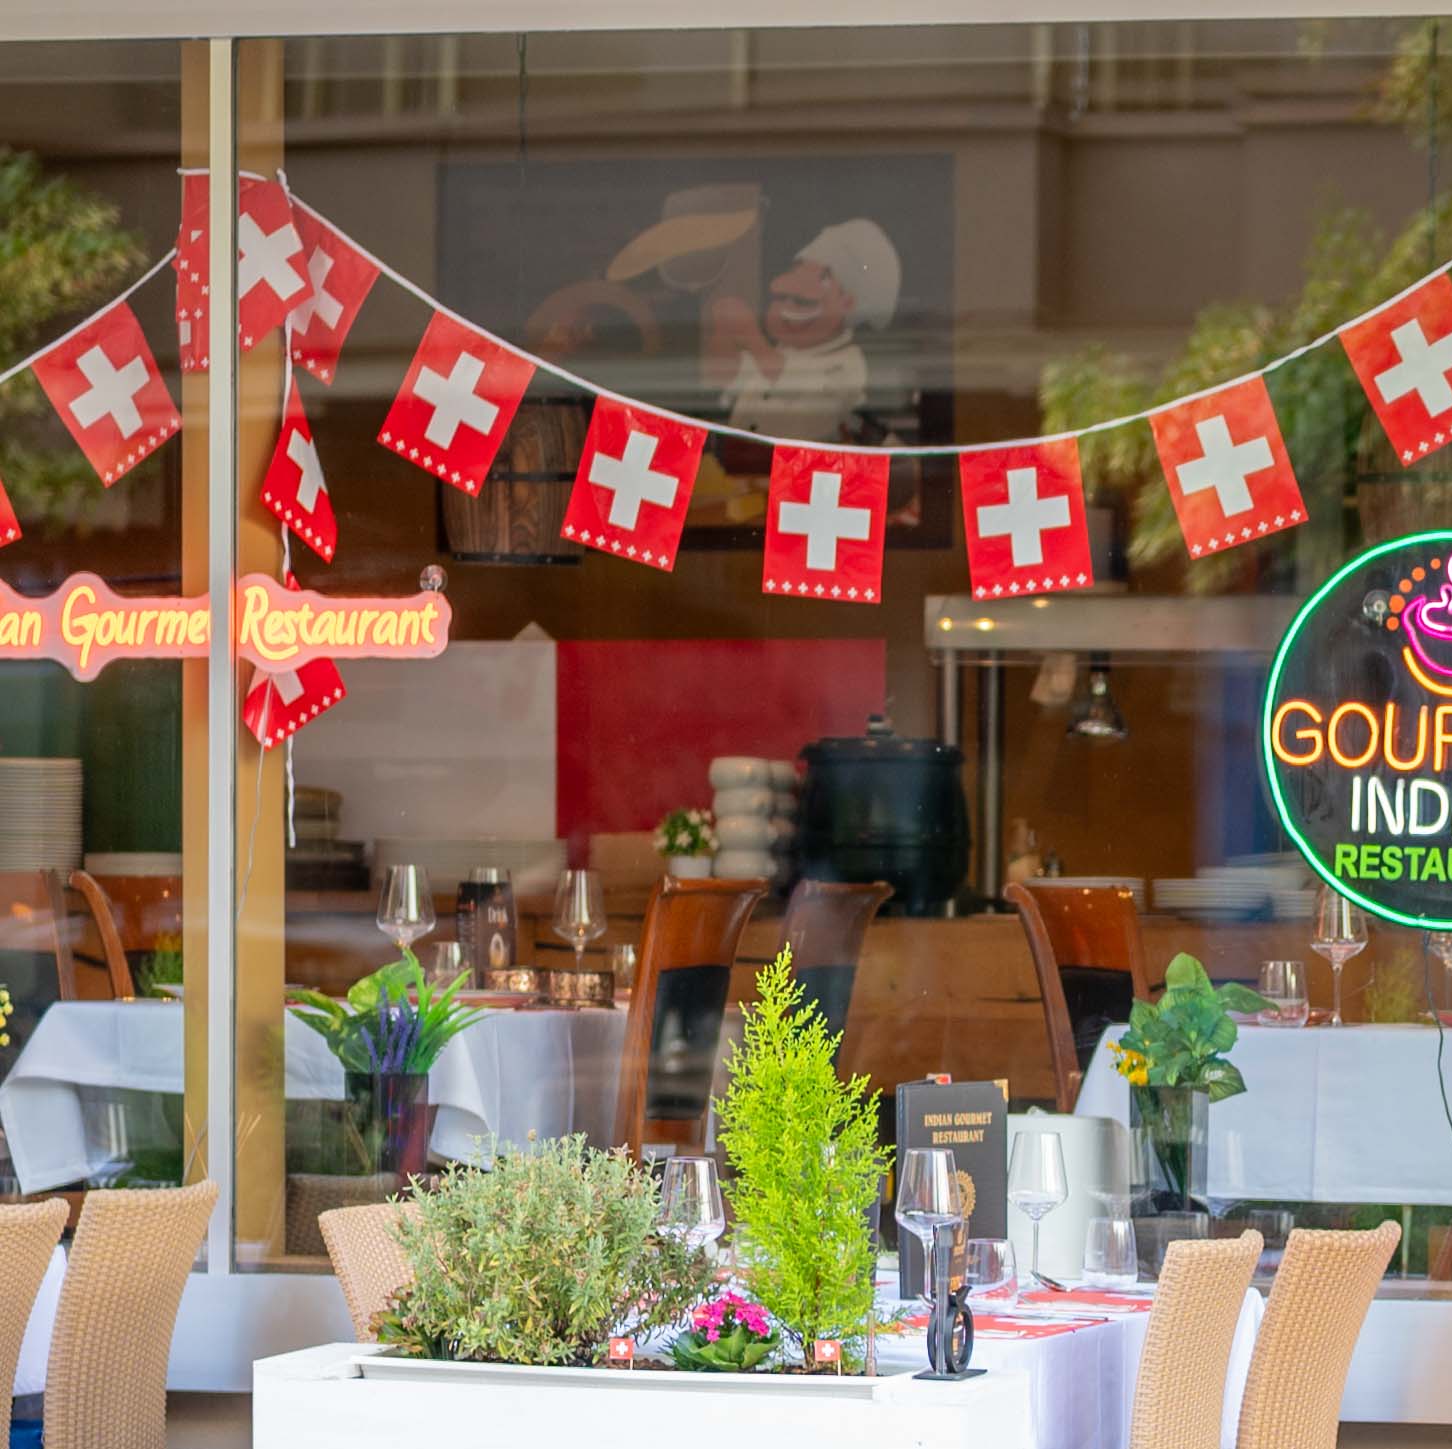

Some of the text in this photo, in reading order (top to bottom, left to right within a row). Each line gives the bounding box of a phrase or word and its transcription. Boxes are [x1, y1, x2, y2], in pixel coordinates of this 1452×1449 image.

[62, 585, 211, 668] Gourme
[240, 585, 438, 661] Restaurant
[924, 1111, 993, 1127] INDIAN GOURMET
[932, 1129, 985, 1144] RESTAURANT
